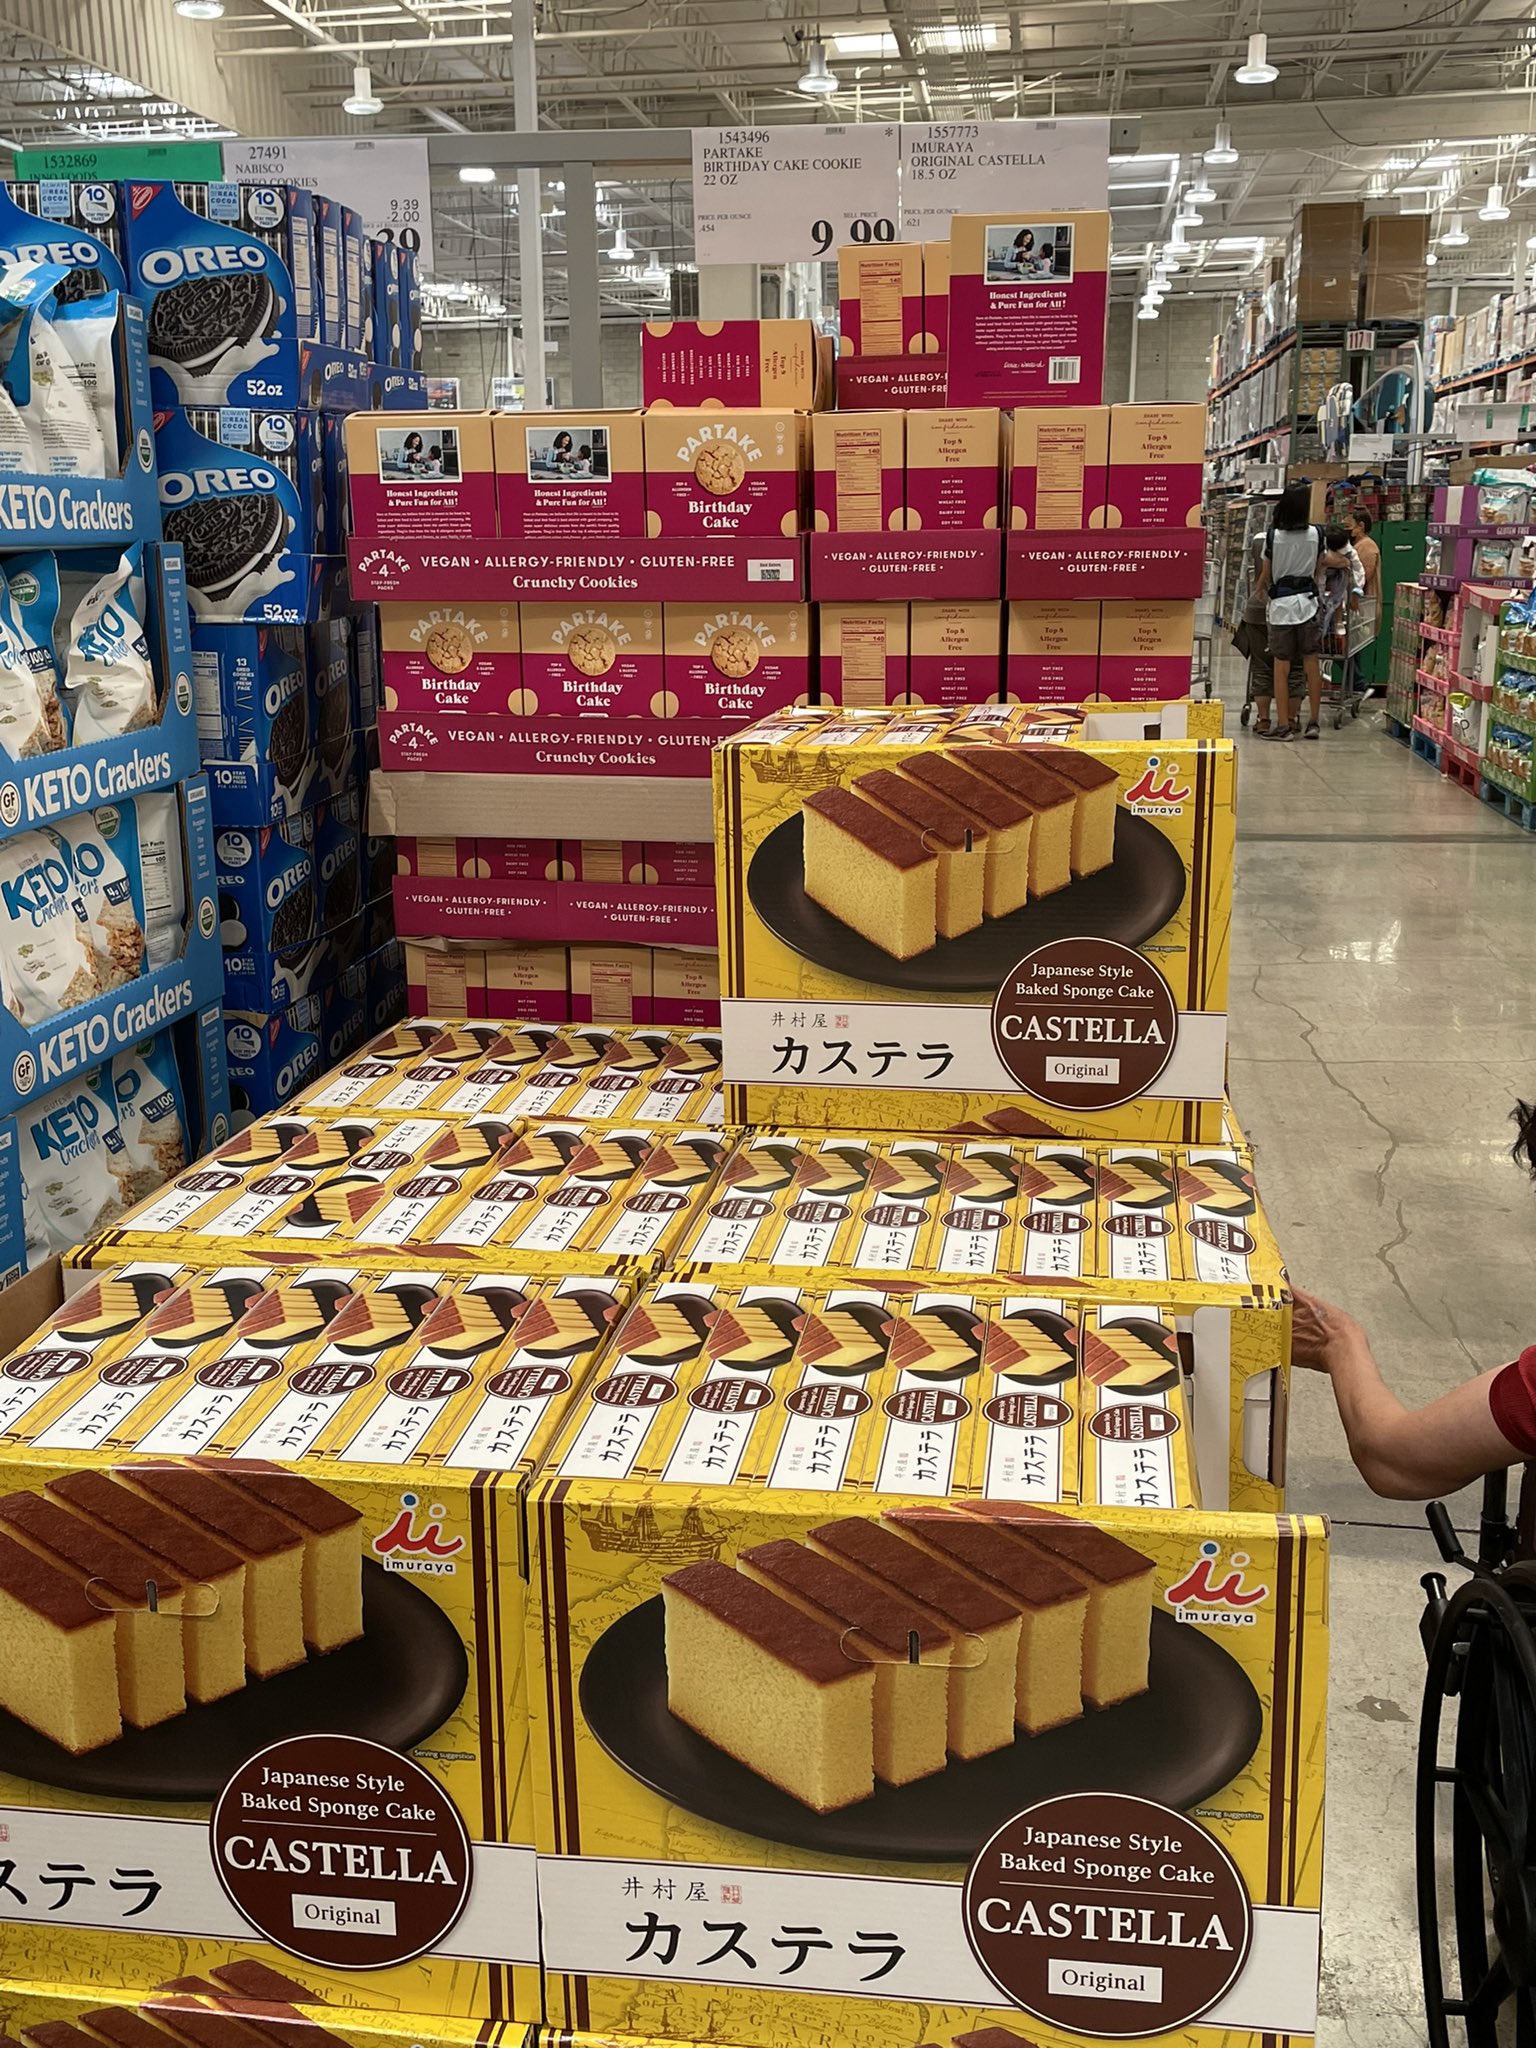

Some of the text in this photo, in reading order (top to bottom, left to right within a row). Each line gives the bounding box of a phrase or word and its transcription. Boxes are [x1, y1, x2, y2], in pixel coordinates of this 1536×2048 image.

[718, 131, 770, 145] 1543496
[928, 126, 979, 139] 1557773
[249, 146, 287, 160] 27491
[703, 147, 763, 159] PARTAKE
[911, 142, 974, 154] IMURAYA
[44, 153, 98, 169] 1532869
[235, 163, 284, 174] NABISCO
[703, 158, 862, 173] BIRTHDAY CAKE COOKIE
[911, 154, 1046, 168] ORIGINAL CASTELLA
[703, 174, 738, 186] 22 OZ
[912, 169, 957, 180] 18.5 OZ
[86, 188, 105, 201] 10
[256, 192, 275, 205] 10
[390, 198, 420, 210] 9.39
[386, 211, 420, 223] -2.00
[905, 218, 921, 227] .621
[699, 224, 716, 233] .454
[141, 245, 267, 284] OREO
[989, 290, 1067, 300] Honest Ingredients
[246, 379, 283, 397] 52oz
[856, 375, 889, 385] VEGAN
[266, 417, 284, 430] 10
[676, 424, 763, 463] PARTAKE
[943, 438, 955, 446] Top
[938, 447, 967, 455] Allergen
[157, 468, 276, 504] OREO
[387, 489, 458, 498] Honest Ingredients
[59, 487, 133, 531] Crackers
[688, 501, 753, 515] Birthday
[702, 516, 740, 528] Cake
[358, 549, 411, 574] PARTAKE
[420, 555, 735, 569] VEGAN ALLERGY-FRIENDLY GLUTEN-FREE
[831, 550, 977, 561] VEGAN ALLERGY-FRIENDLY
[1028, 550, 1181, 561] VEGAN ALLERGY-FRIENDLY
[378, 564, 389, 578] 4
[868, 564, 937, 573] GLUTEN-FREE
[1067, 563, 1138, 573] GLUTEN-FREE
[512, 575, 638, 590] Crunchy Cookies
[263, 604, 299, 623] 52oz
[409, 608, 489, 644] PARTAKE
[694, 611, 777, 648] PARTAKE
[236, 658, 247, 667] 13
[315, 659, 348, 698] OREO
[422, 679, 481, 692] Birthday
[265, 670, 304, 715] OREO
[435, 692, 470, 704] Cake
[704, 683, 767, 697] Birthday
[718, 698, 753, 709] Cake
[389, 722, 438, 746] PARTAKE
[448, 730, 641, 746] VEGAN ALLERGY-FRIENDLY
[408, 737, 419, 749] 4
[536, 750, 657, 766] Crunchy Cookies
[24, 749, 171, 822] KETO Crackers
[214, 770, 232, 785] 10
[3, 790, 16, 808] GF
[1132, 804, 1183, 817] imuraya
[1, 858, 69, 921] KETO
[266, 858, 312, 909] OREO
[411, 894, 541, 906] VEGAN ALLERGY-FRIENDLY
[575, 901, 708, 914] VEGAN ALLERGY-FRIENDLY
[445, 907, 505, 916] GLUTEN-FREE
[610, 913, 672, 923] GLUTEN-FREE
[224, 957, 242, 972] 10
[1031, 963, 1134, 981] Japanese Style
[1016, 983, 1155, 1001] Baked Sponge Cake
[771, 1011, 829, 1029] 井村屋
[39, 979, 193, 1084] KETO Crackers
[1000, 1014, 1167, 1046] CASTELLA
[771, 1036, 956, 1081] カステラ
[18, 1060, 31, 1078] GF
[276, 1041, 319, 1097] OREO
[1054, 1061, 1110, 1080] Original
[30, 1094, 99, 1161] KETO
[722, 1222, 748, 1259] カステラ
[881, 1230, 902, 1265] カステラ
[1050, 1237, 1073, 1274] カステラ
[78, 1391, 136, 1437] カステラ
[277, 1400, 331, 1450] カステラ
[487, 1404, 533, 1456] カステラ
[601, 1412, 642, 1465] カステラ
[702, 1418, 741, 1471] カステラ
[805, 1424, 842, 1477] カステラ
[912, 1429, 945, 1482] カステラ
[1021, 1432, 1050, 1487] カステラ
[1133, 1446, 1161, 1507] カステラ
[385, 1558, 454, 1575] imuraya
[1178, 1609, 1255, 1624] imuraya
[414, 1749, 476, 1762] Serving suggestion
[262, 1766, 405, 1794] Japanese Style
[241, 1792, 437, 1822] Baked Sponge Cake
[1195, 1808, 1264, 1821] Serving suggestion
[1023, 1826, 1183, 1858] Japanese Style
[224, 1834, 458, 1886] CASTELLA
[1000, 1853, 1216, 1885] Baked Sponge Cake
[622, 1876, 711, 1903] 井村屋
[304, 1903, 381, 1927] Original
[977, 1897, 1235, 1951] CASTELLA
[625, 1911, 907, 1982] カステラ
[1061, 1968, 1147, 1994] Original
